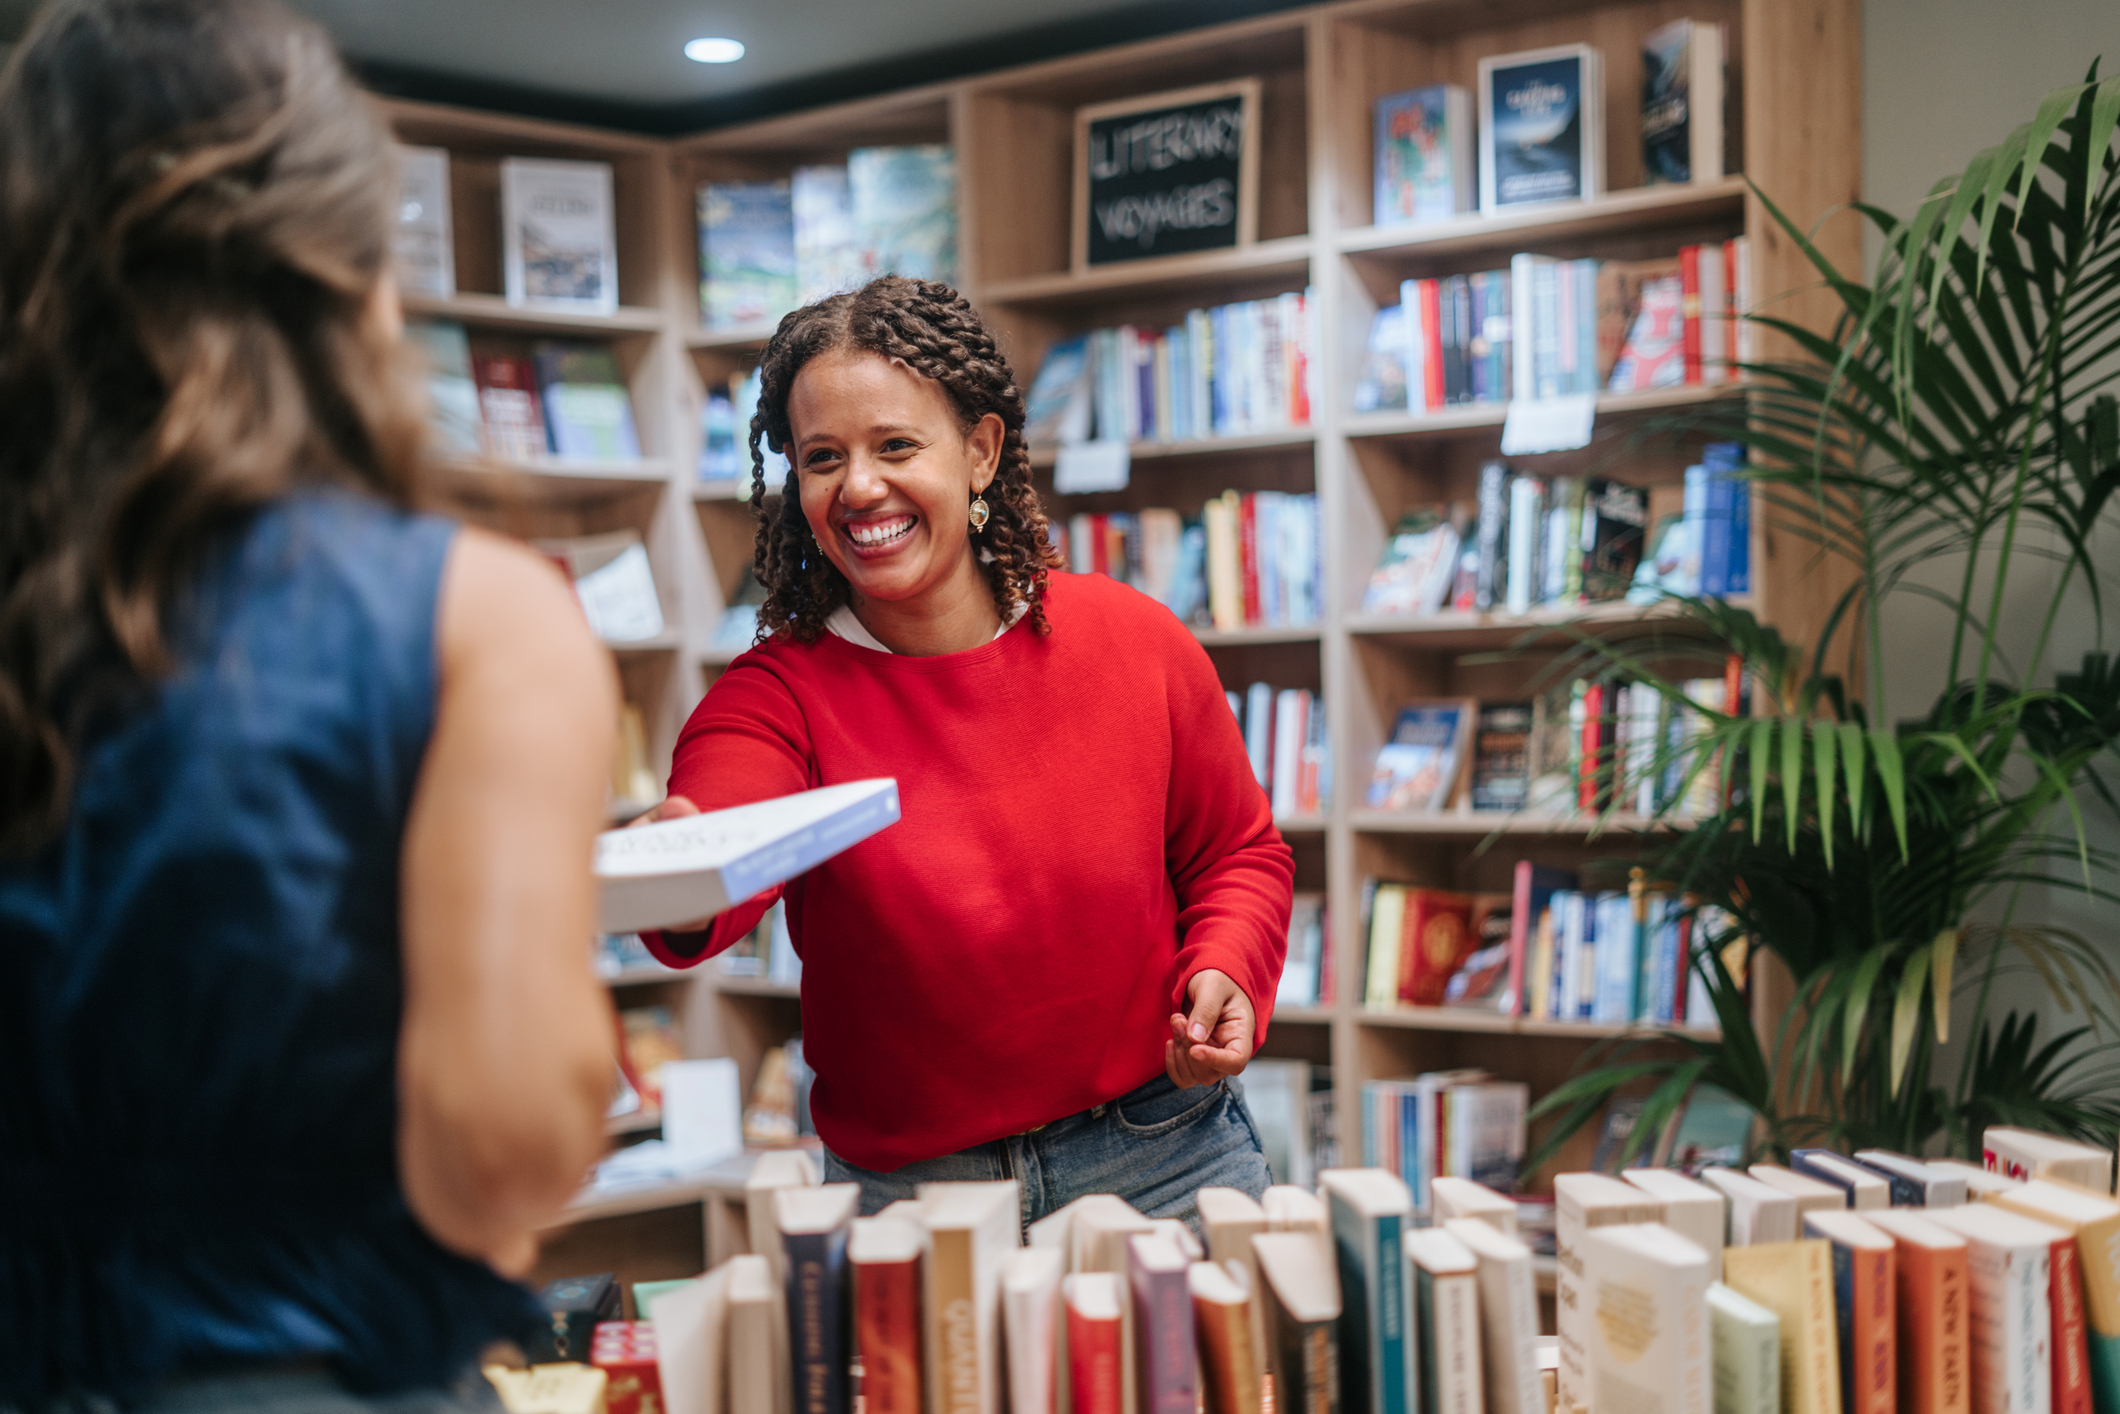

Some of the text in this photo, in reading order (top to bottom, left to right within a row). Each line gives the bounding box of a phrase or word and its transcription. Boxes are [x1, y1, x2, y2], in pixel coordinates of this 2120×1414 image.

[1094, 178, 1234, 248] VOYAGES
[1942, 1290, 1959, 1332] NEW
[1942, 1344, 1960, 1407] EARTH
